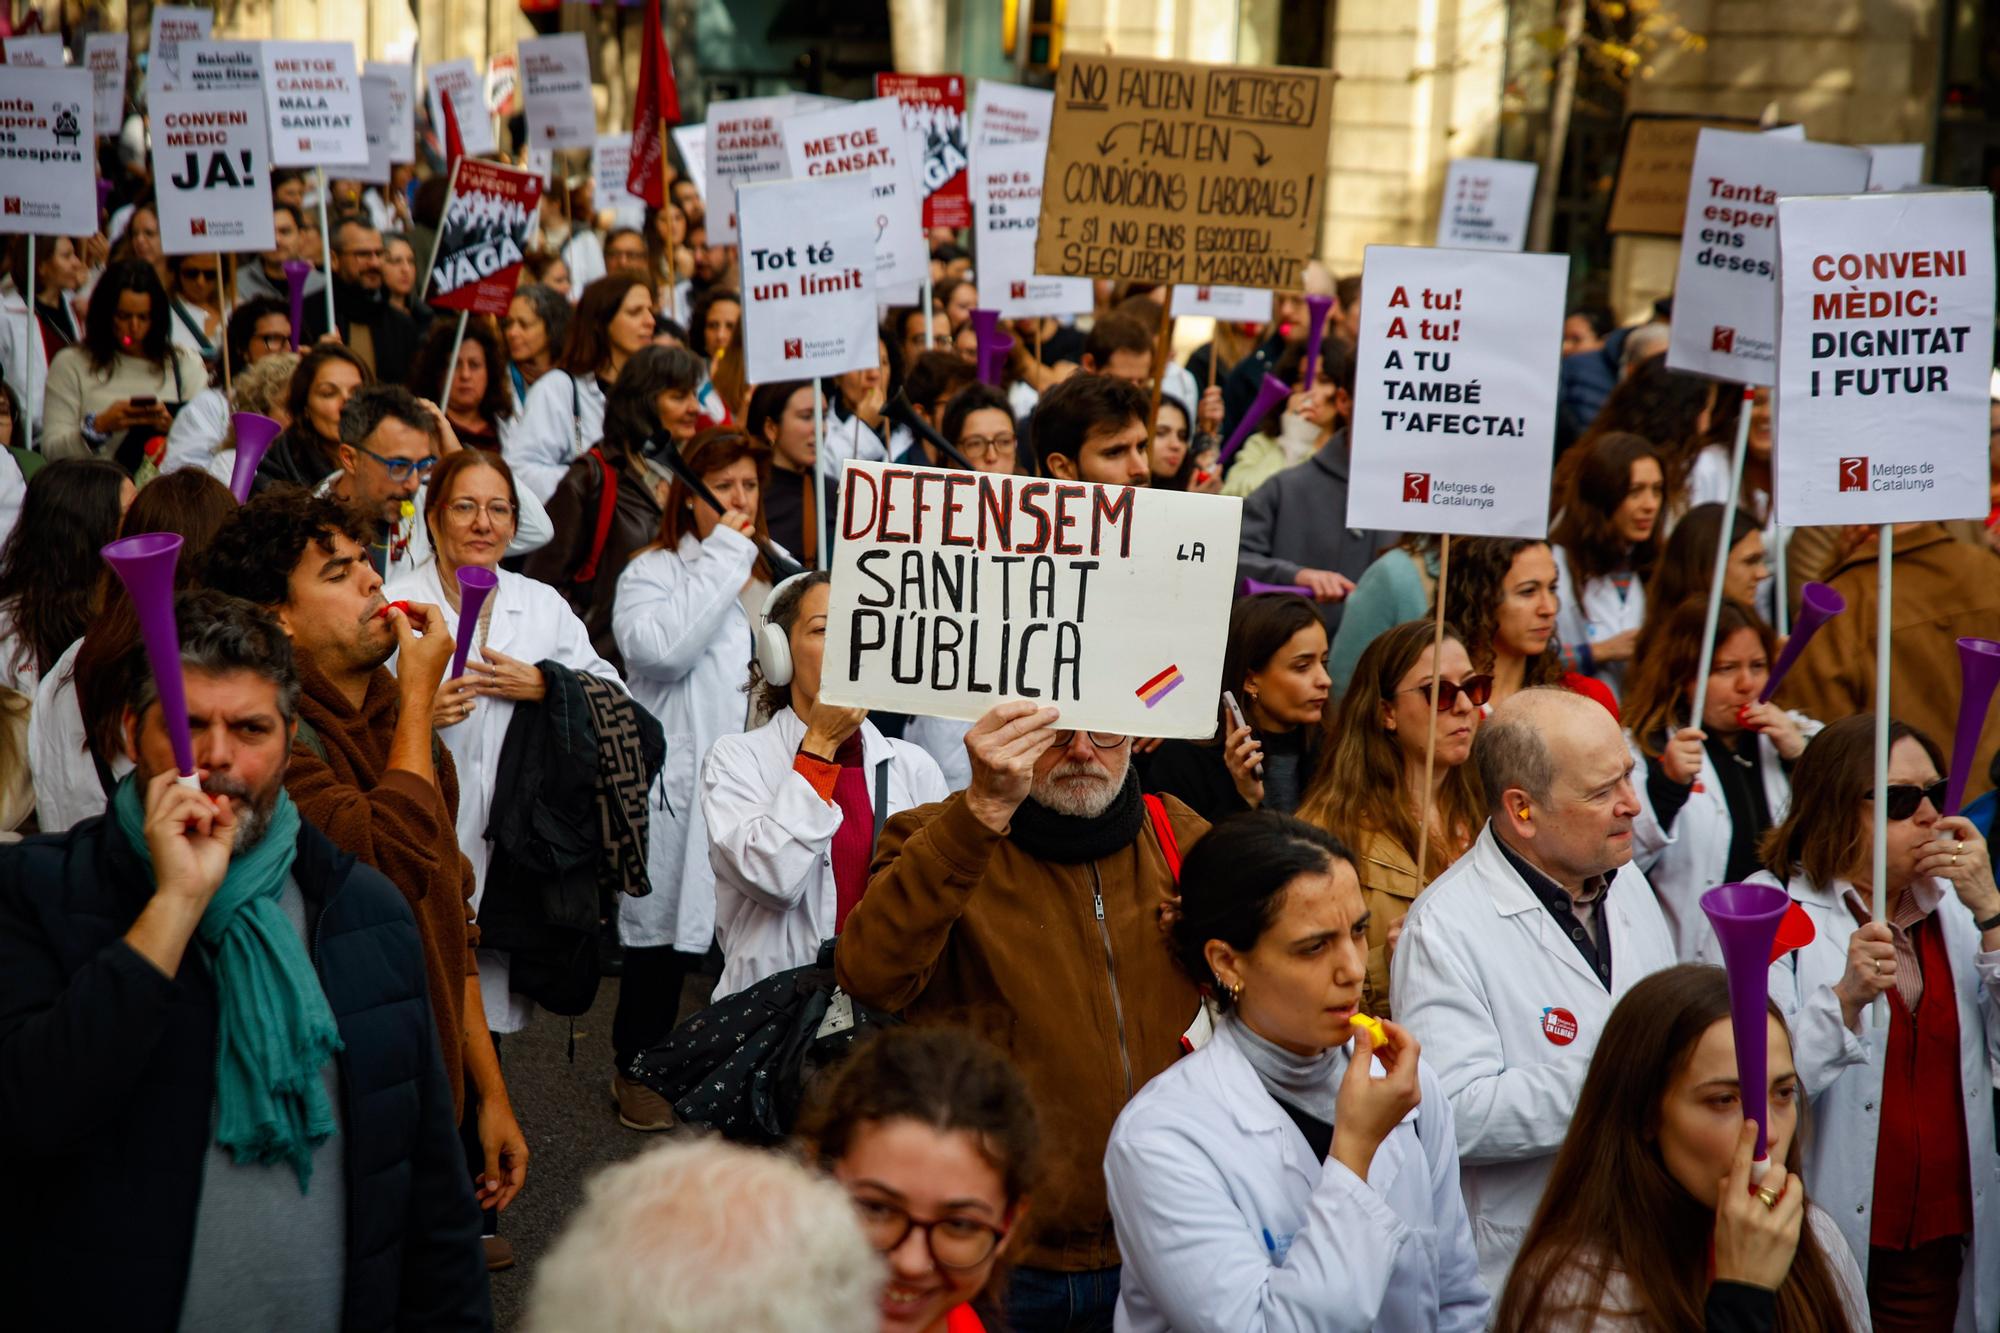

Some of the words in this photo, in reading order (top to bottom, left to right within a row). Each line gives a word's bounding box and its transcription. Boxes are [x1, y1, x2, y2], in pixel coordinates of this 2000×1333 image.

[274, 60, 335, 72] METGE
[277, 79, 350, 94] CANSAT,
[1070, 63, 1108, 102] NO
[1118, 66, 1195, 111] FALTEN
[1212, 75, 1305, 124] METGES
[0, 98, 34, 112] nta
[279, 97, 328, 110] MALA
[165, 111, 247, 127] CONVENI
[281, 116, 352, 129] SANITAT
[718, 118, 774, 134] METGE
[166, 129, 227, 146] MÈDIC
[717, 133, 784, 151] CANSAT,
[804, 128, 879, 158] METGE
[1140, 119, 1231, 162] FALTEN
[171, 150, 255, 190] JA!
[808, 148, 896, 177] CANSAT,
[923, 143, 967, 192] GA
[988, 174, 1008, 185] NO
[1013, 171, 1030, 183] ÉS
[988, 187, 1041, 199] VOCACI
[1709, 177, 1777, 205] Tanta
[989, 202, 1006, 214] ÉS
[1704, 205, 1775, 229] esper
[989, 218, 1039, 230] EXPLO
[1056, 217, 1072, 239] I
[1081, 217, 1098, 243] SI
[1110, 220, 1139, 246] NO
[1146, 223, 1186, 251] ENS
[1701, 228, 1744, 248] ens
[433, 236, 524, 296] VAGA
[751, 246, 797, 271] Tot
[806, 240, 834, 265] té
[1061, 242, 1185, 280] SEGUIREM
[1195, 254, 1301, 286] MARXANT
[1812, 250, 1967, 282] CONVENI
[753, 281, 789, 301] un
[800, 267, 863, 296] límit
[1388, 285, 1410, 308] A
[1421, 288, 1463, 311] tu!
[1813, 285, 1938, 320] MÈDIC:
[1386, 316, 1408, 339] A
[1419, 319, 1461, 341] tu!
[1811, 326, 1971, 359] DIGNITAT
[1384, 350, 1403, 370] A
[1414, 351, 1451, 372] TU
[1383, 379, 1482, 404] TAMBÉ
[1811, 370, 1820, 397] I
[1835, 365, 1949, 397] FUTUR
[1381, 411, 1525, 437] T'AFECTA!
[1872, 463, 1918, 478] Metges
[1920, 462, 1934, 473] de
[1433, 480, 1478, 495] Metges
[1480, 481, 1495, 495] de
[1872, 478, 1934, 496] Catalunya
[1432, 493, 1495, 509] Catalunya
[842, 467, 1136, 558] DEFENSEM
[1176, 542, 1205, 563] LA
[856, 549, 1099, 623] SANITAT
[848, 608, 1082, 702] PÚBLICA
